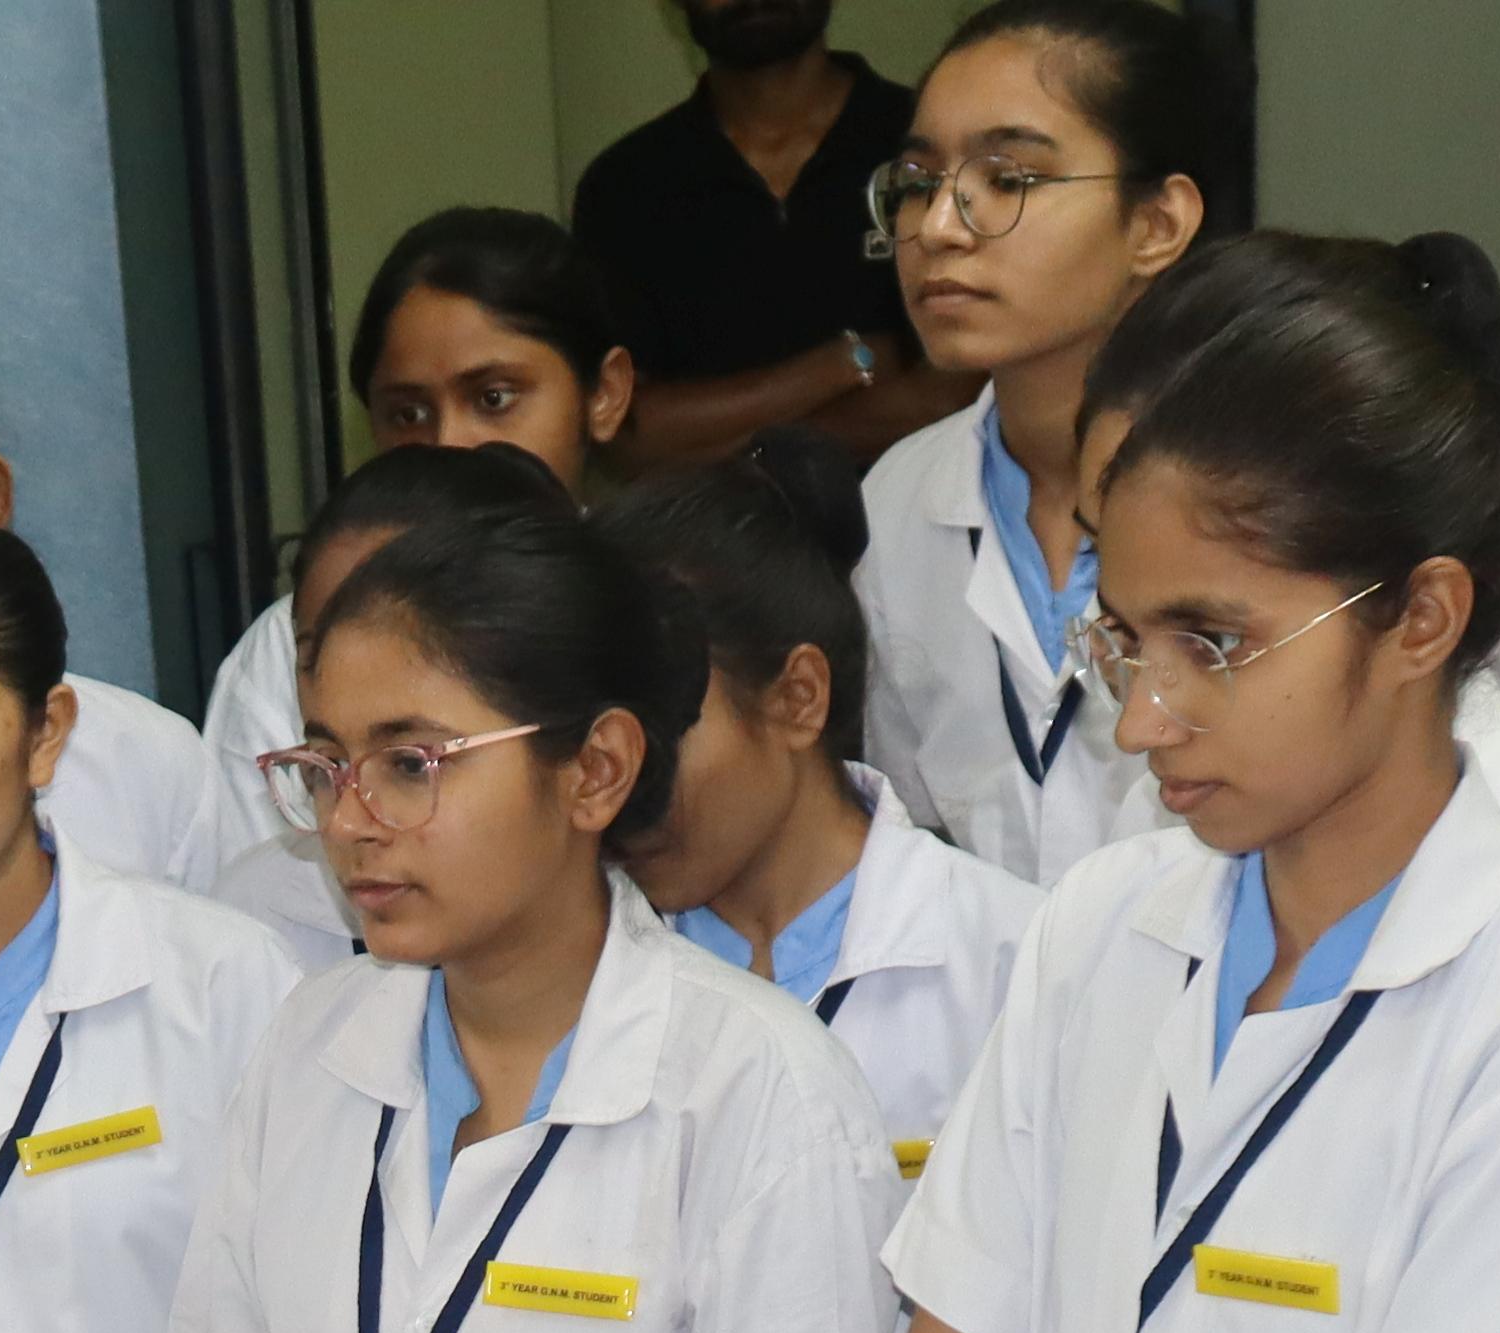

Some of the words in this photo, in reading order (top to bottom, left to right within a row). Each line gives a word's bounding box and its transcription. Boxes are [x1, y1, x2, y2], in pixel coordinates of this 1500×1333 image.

[46, 1144, 72, 1156] YEAR
[104, 1126, 146, 1142] STUDENT
[512, 1283, 538, 1294] YEAR
[573, 1290, 620, 1304] STUDENT
[1220, 1270, 1242, 1282] YEAR
[1276, 1281, 1320, 1296] STUDENT
